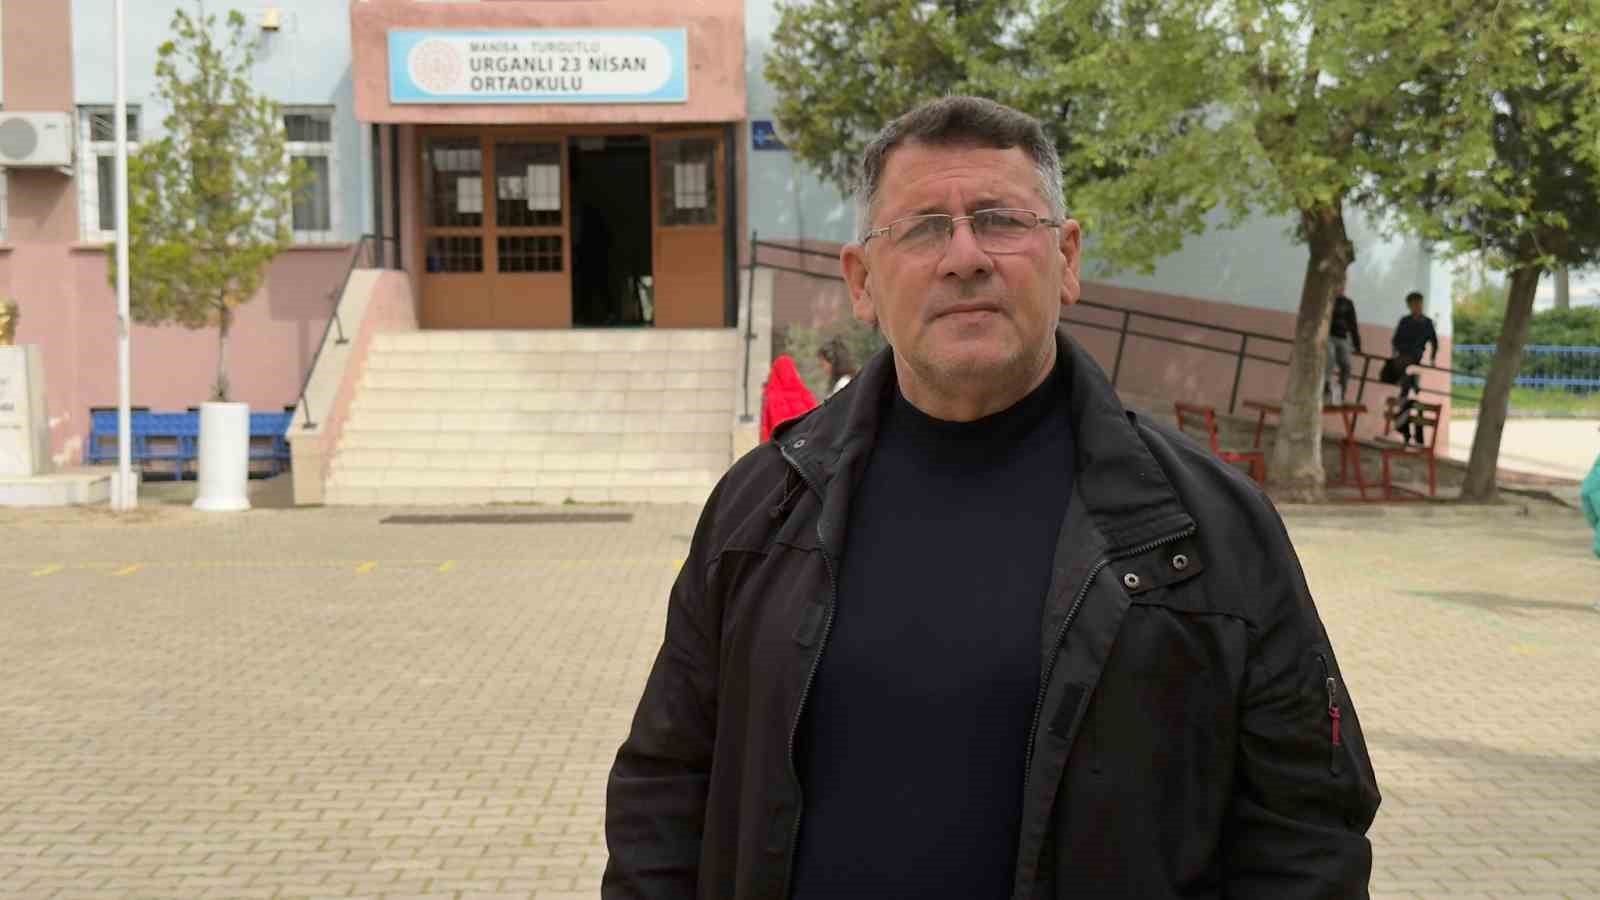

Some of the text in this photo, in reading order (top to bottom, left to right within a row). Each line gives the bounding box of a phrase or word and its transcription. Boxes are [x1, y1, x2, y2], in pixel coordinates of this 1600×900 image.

[470, 57, 553, 72] URGANLI
[560, 57, 582, 72] 23
[470, 76, 582, 91] ORTAOKULU
